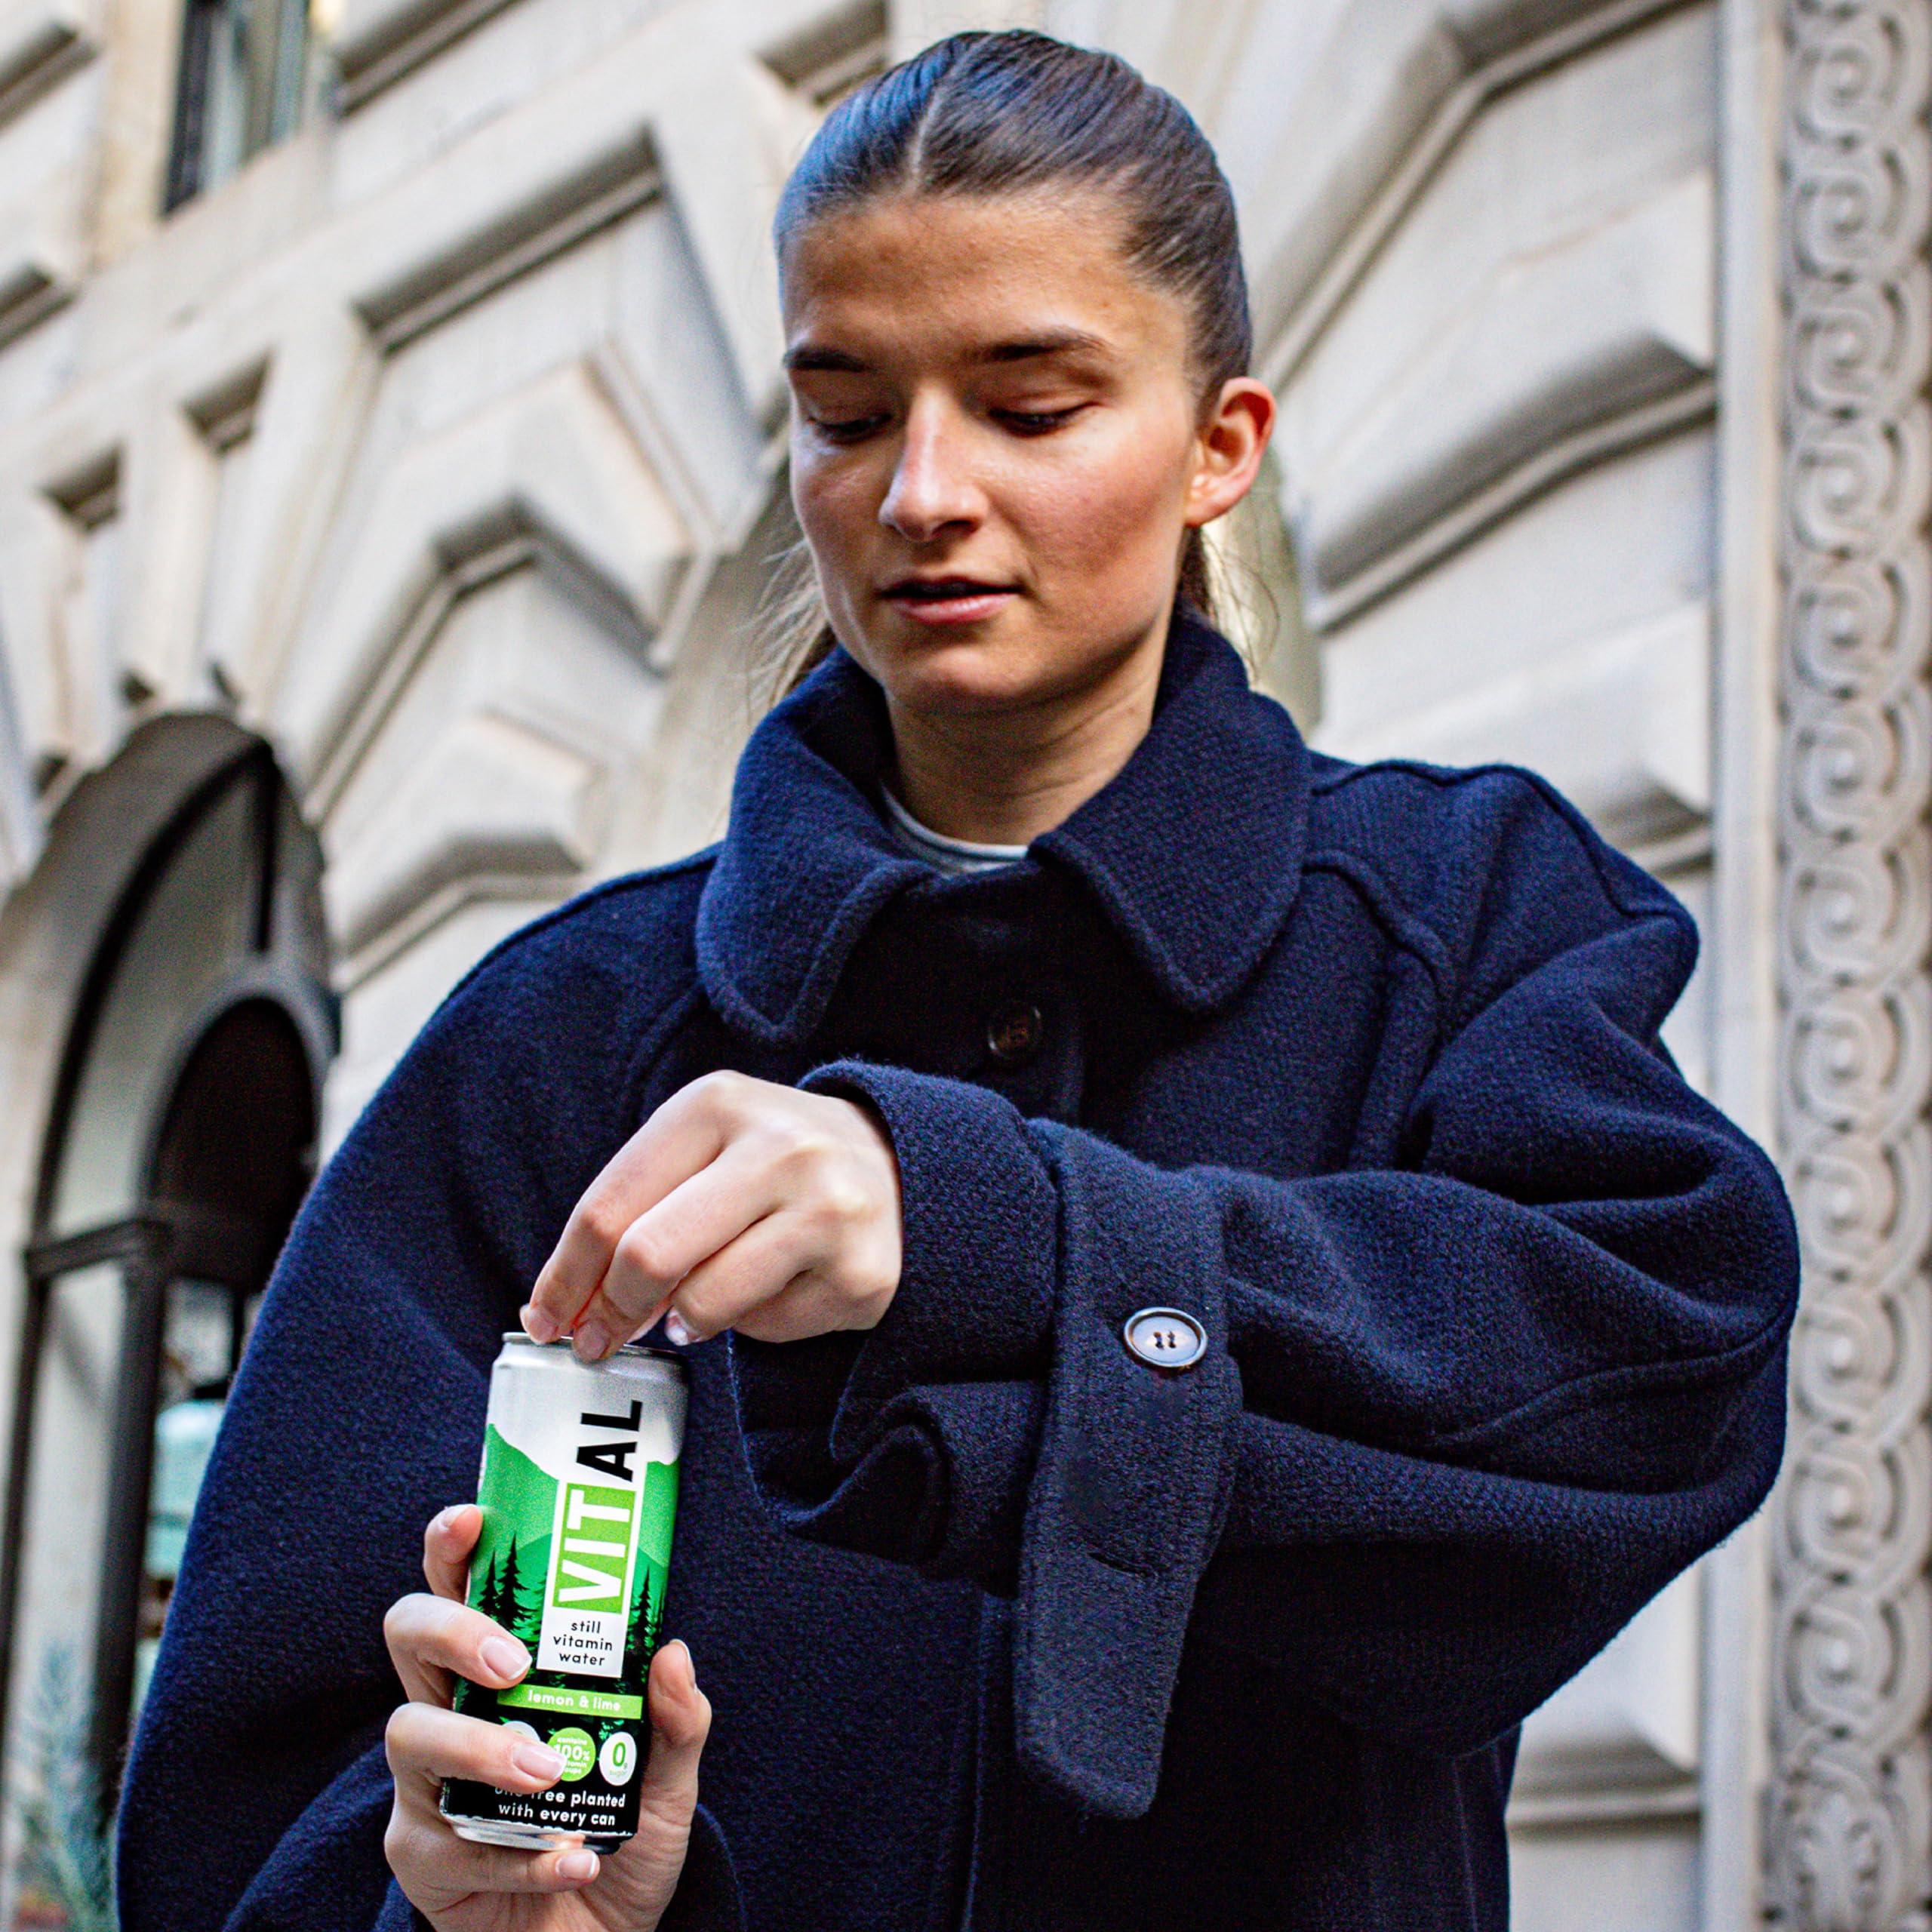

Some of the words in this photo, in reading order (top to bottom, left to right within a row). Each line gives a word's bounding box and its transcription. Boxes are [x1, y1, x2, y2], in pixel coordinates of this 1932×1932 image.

[558, 1400, 642, 1601] VITAL
[571, 1620, 601, 1633] still
[553, 1634, 613, 1651] vitamin
[559, 1653, 605, 1666] water
[528, 1690, 574, 1707] lemon
[579, 1695, 589, 1708] &
[593, 1697, 620, 1711] lime
[571, 1790, 626, 1807] planted
[499, 1802, 534, 1818] with
[540, 1810, 586, 1826] every
[591, 1814, 615, 1826] can
